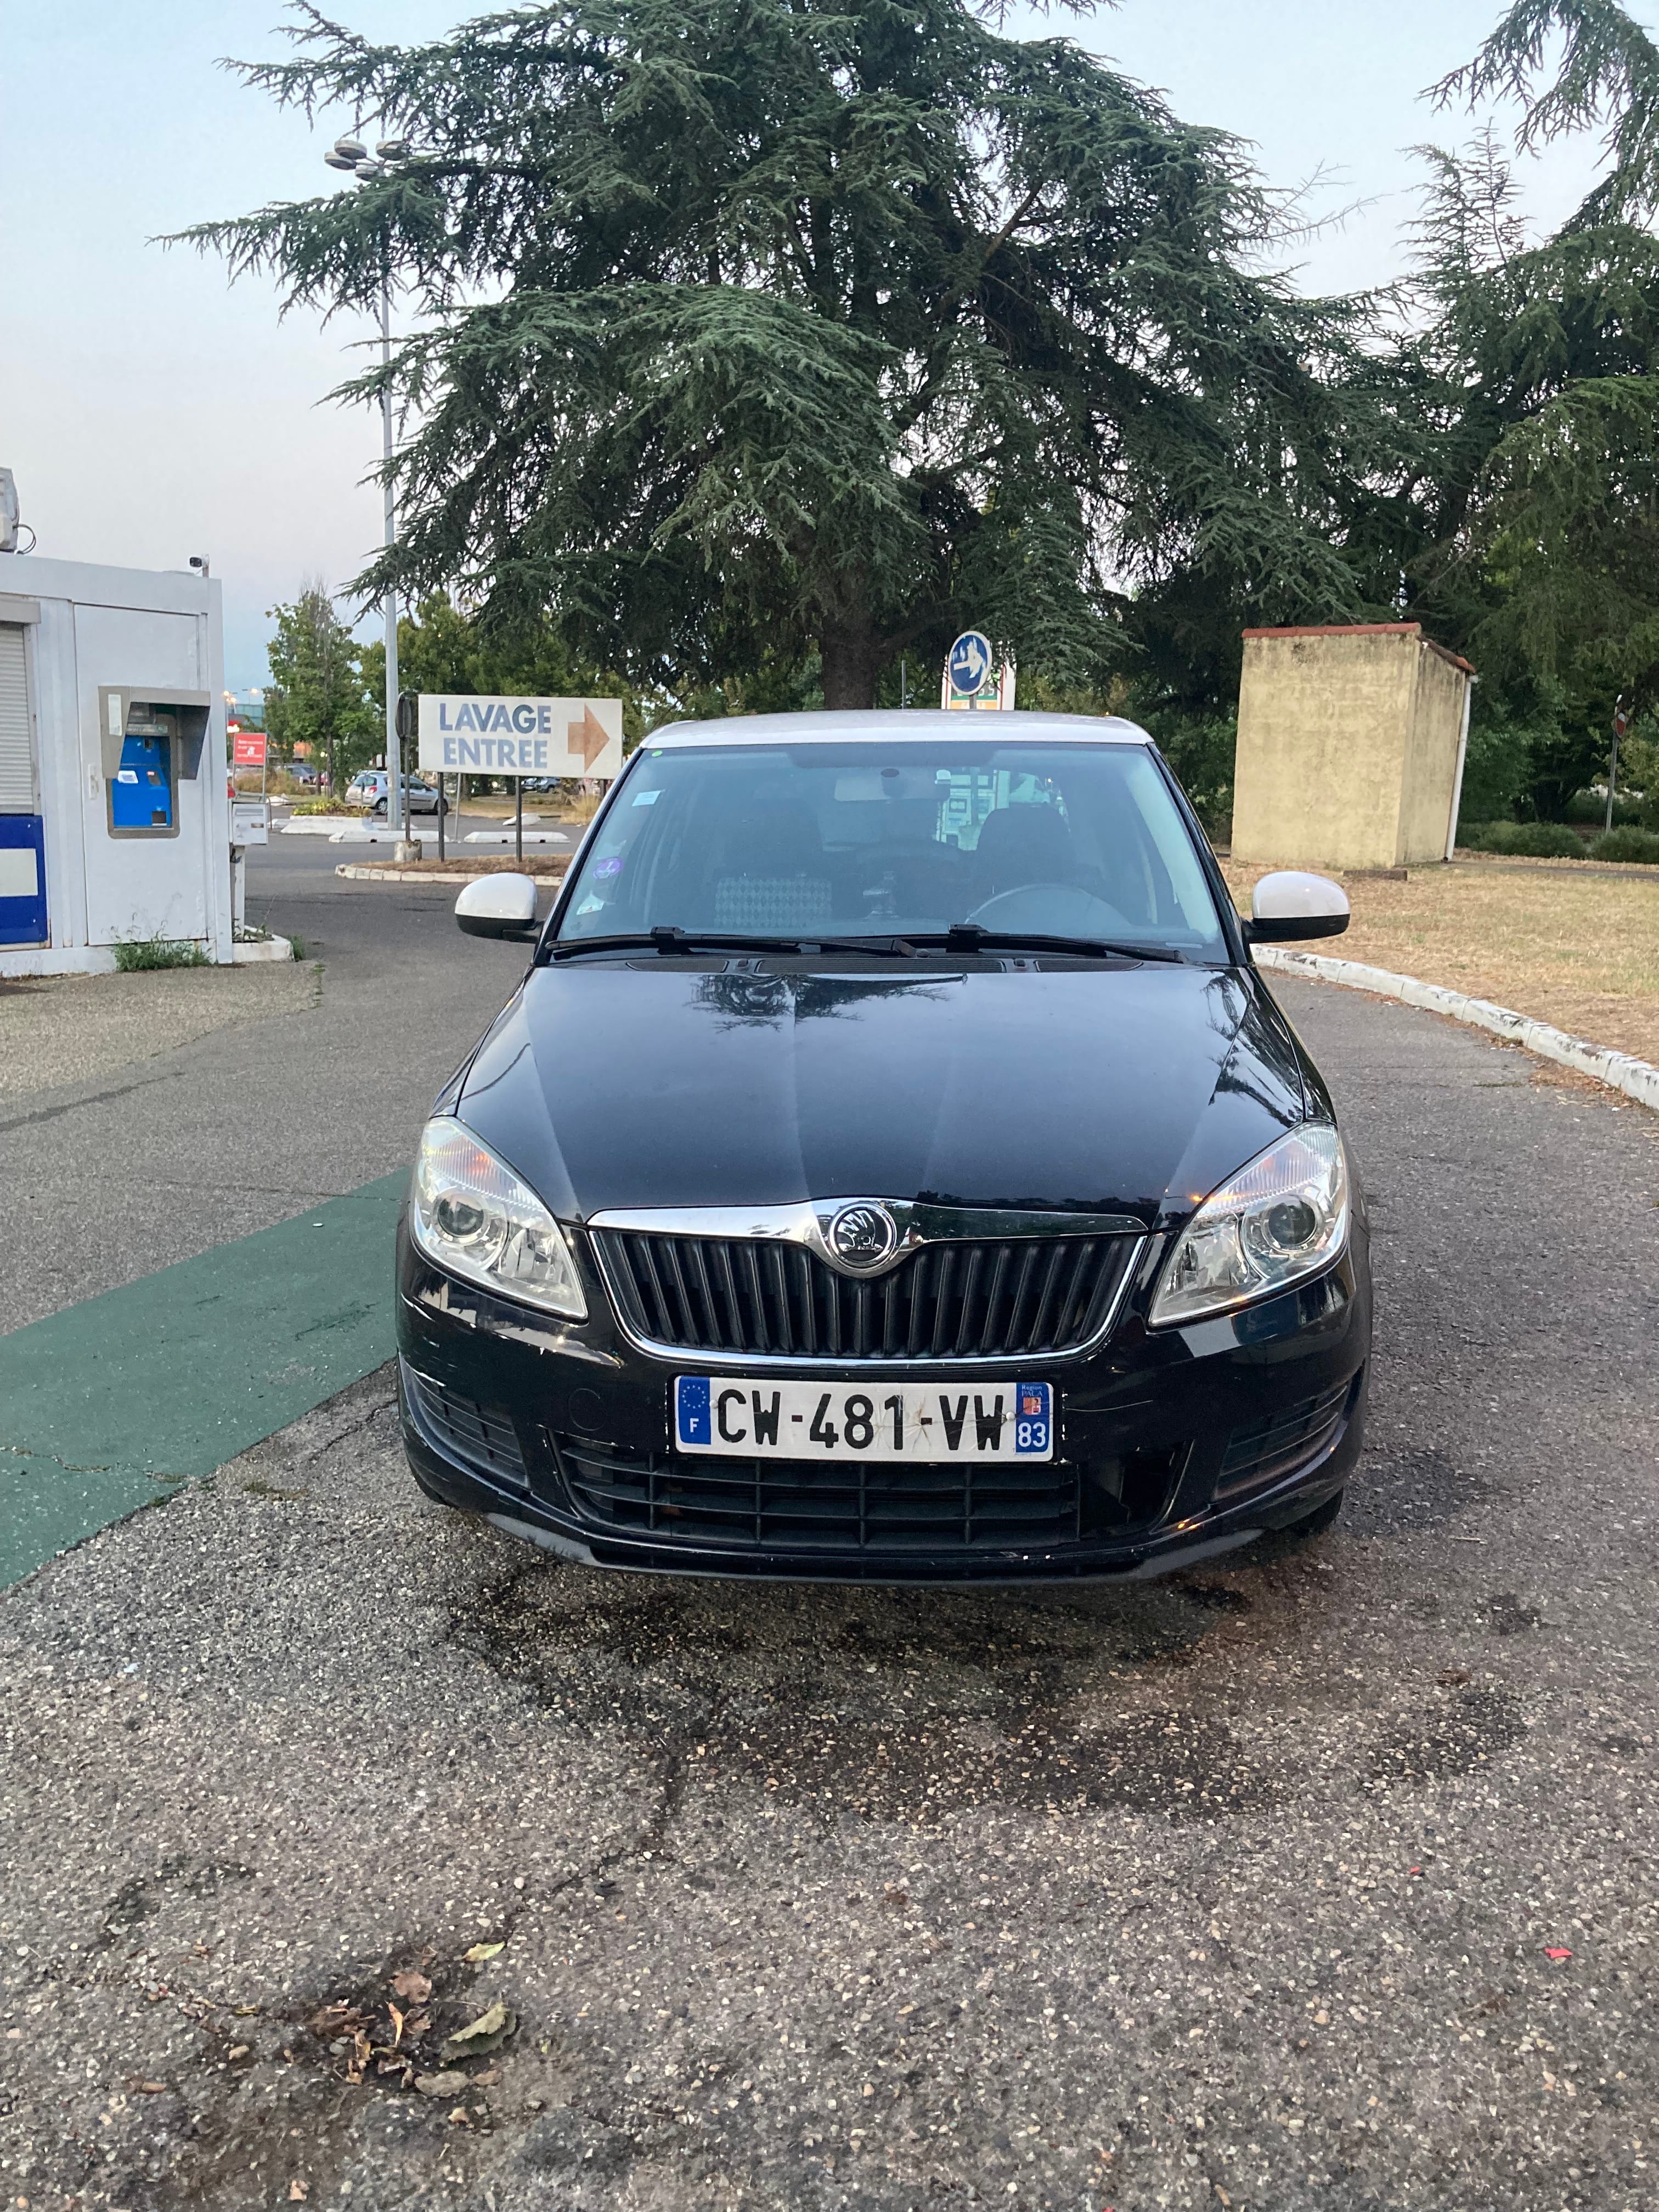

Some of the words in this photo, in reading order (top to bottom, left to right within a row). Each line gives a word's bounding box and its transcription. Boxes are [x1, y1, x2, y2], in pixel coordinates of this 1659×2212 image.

[440, 703, 551, 734] LAVAGE
[444, 737, 548, 769] ENTREE
[690, 1418, 699, 1433] F
[717, 1389, 1004, 1451] CW-481-VW
[1018, 1422, 1046, 1447] 83
